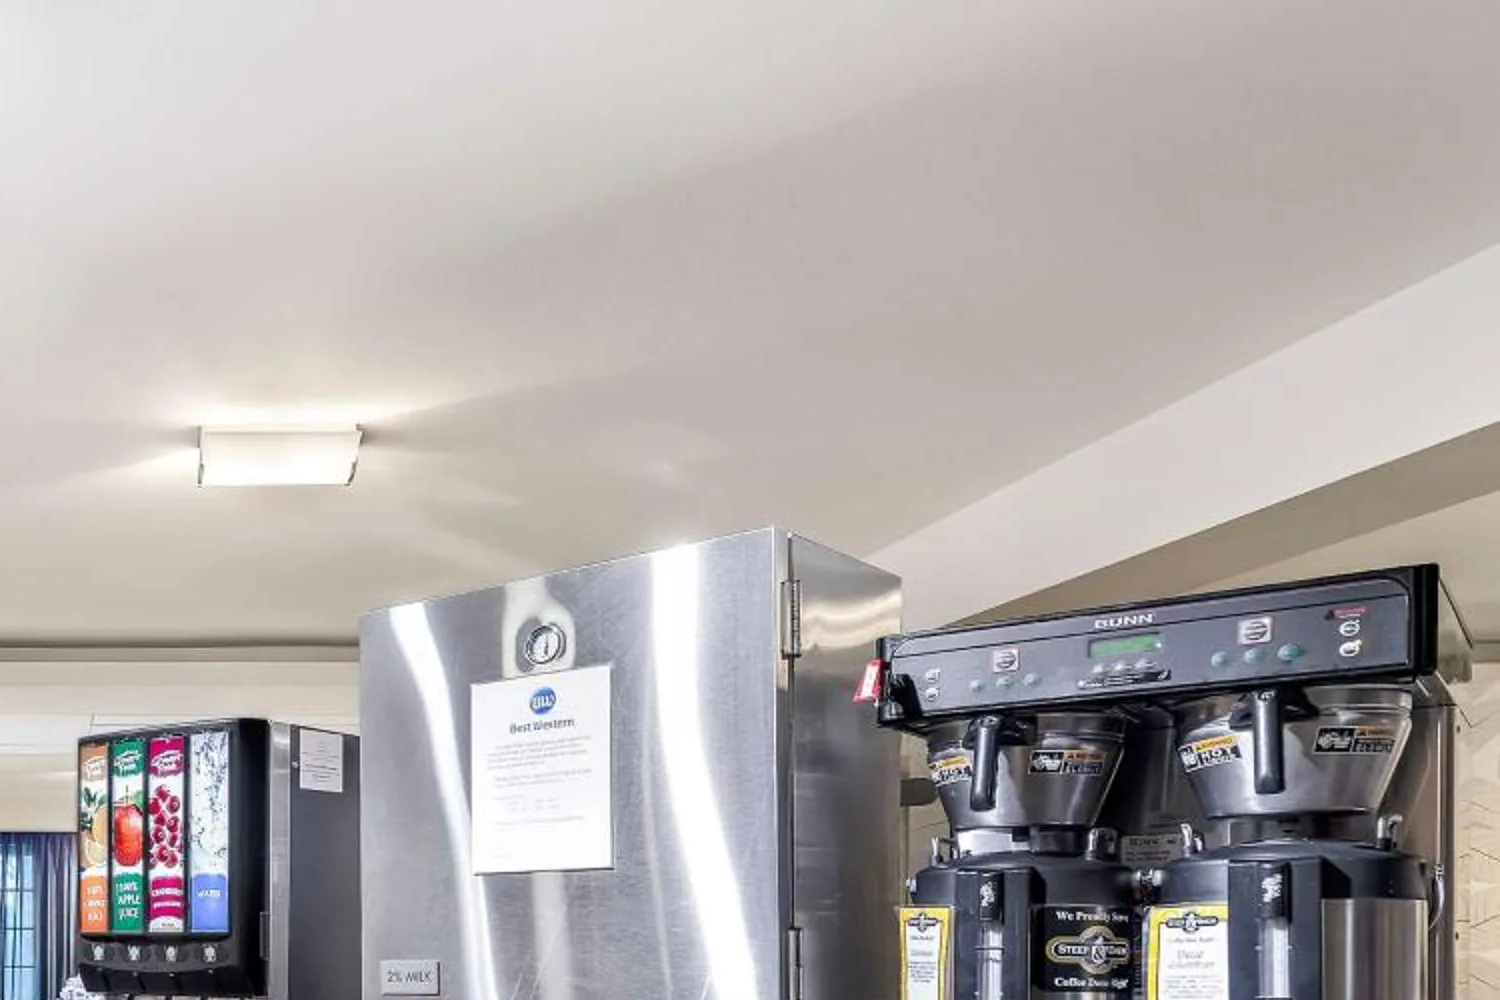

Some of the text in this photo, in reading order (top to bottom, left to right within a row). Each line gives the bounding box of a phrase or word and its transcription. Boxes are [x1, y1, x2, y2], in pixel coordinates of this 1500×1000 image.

[1094, 613, 1153, 629] BUNN
[509, 718, 576, 735] Best Western
[117, 893, 141, 905] APPLE
[118, 908, 139, 920] JUICE
[1055, 911, 1075, 921] We
[405, 970, 432, 983] MILK
[1053, 976, 1087, 988] Coffee
